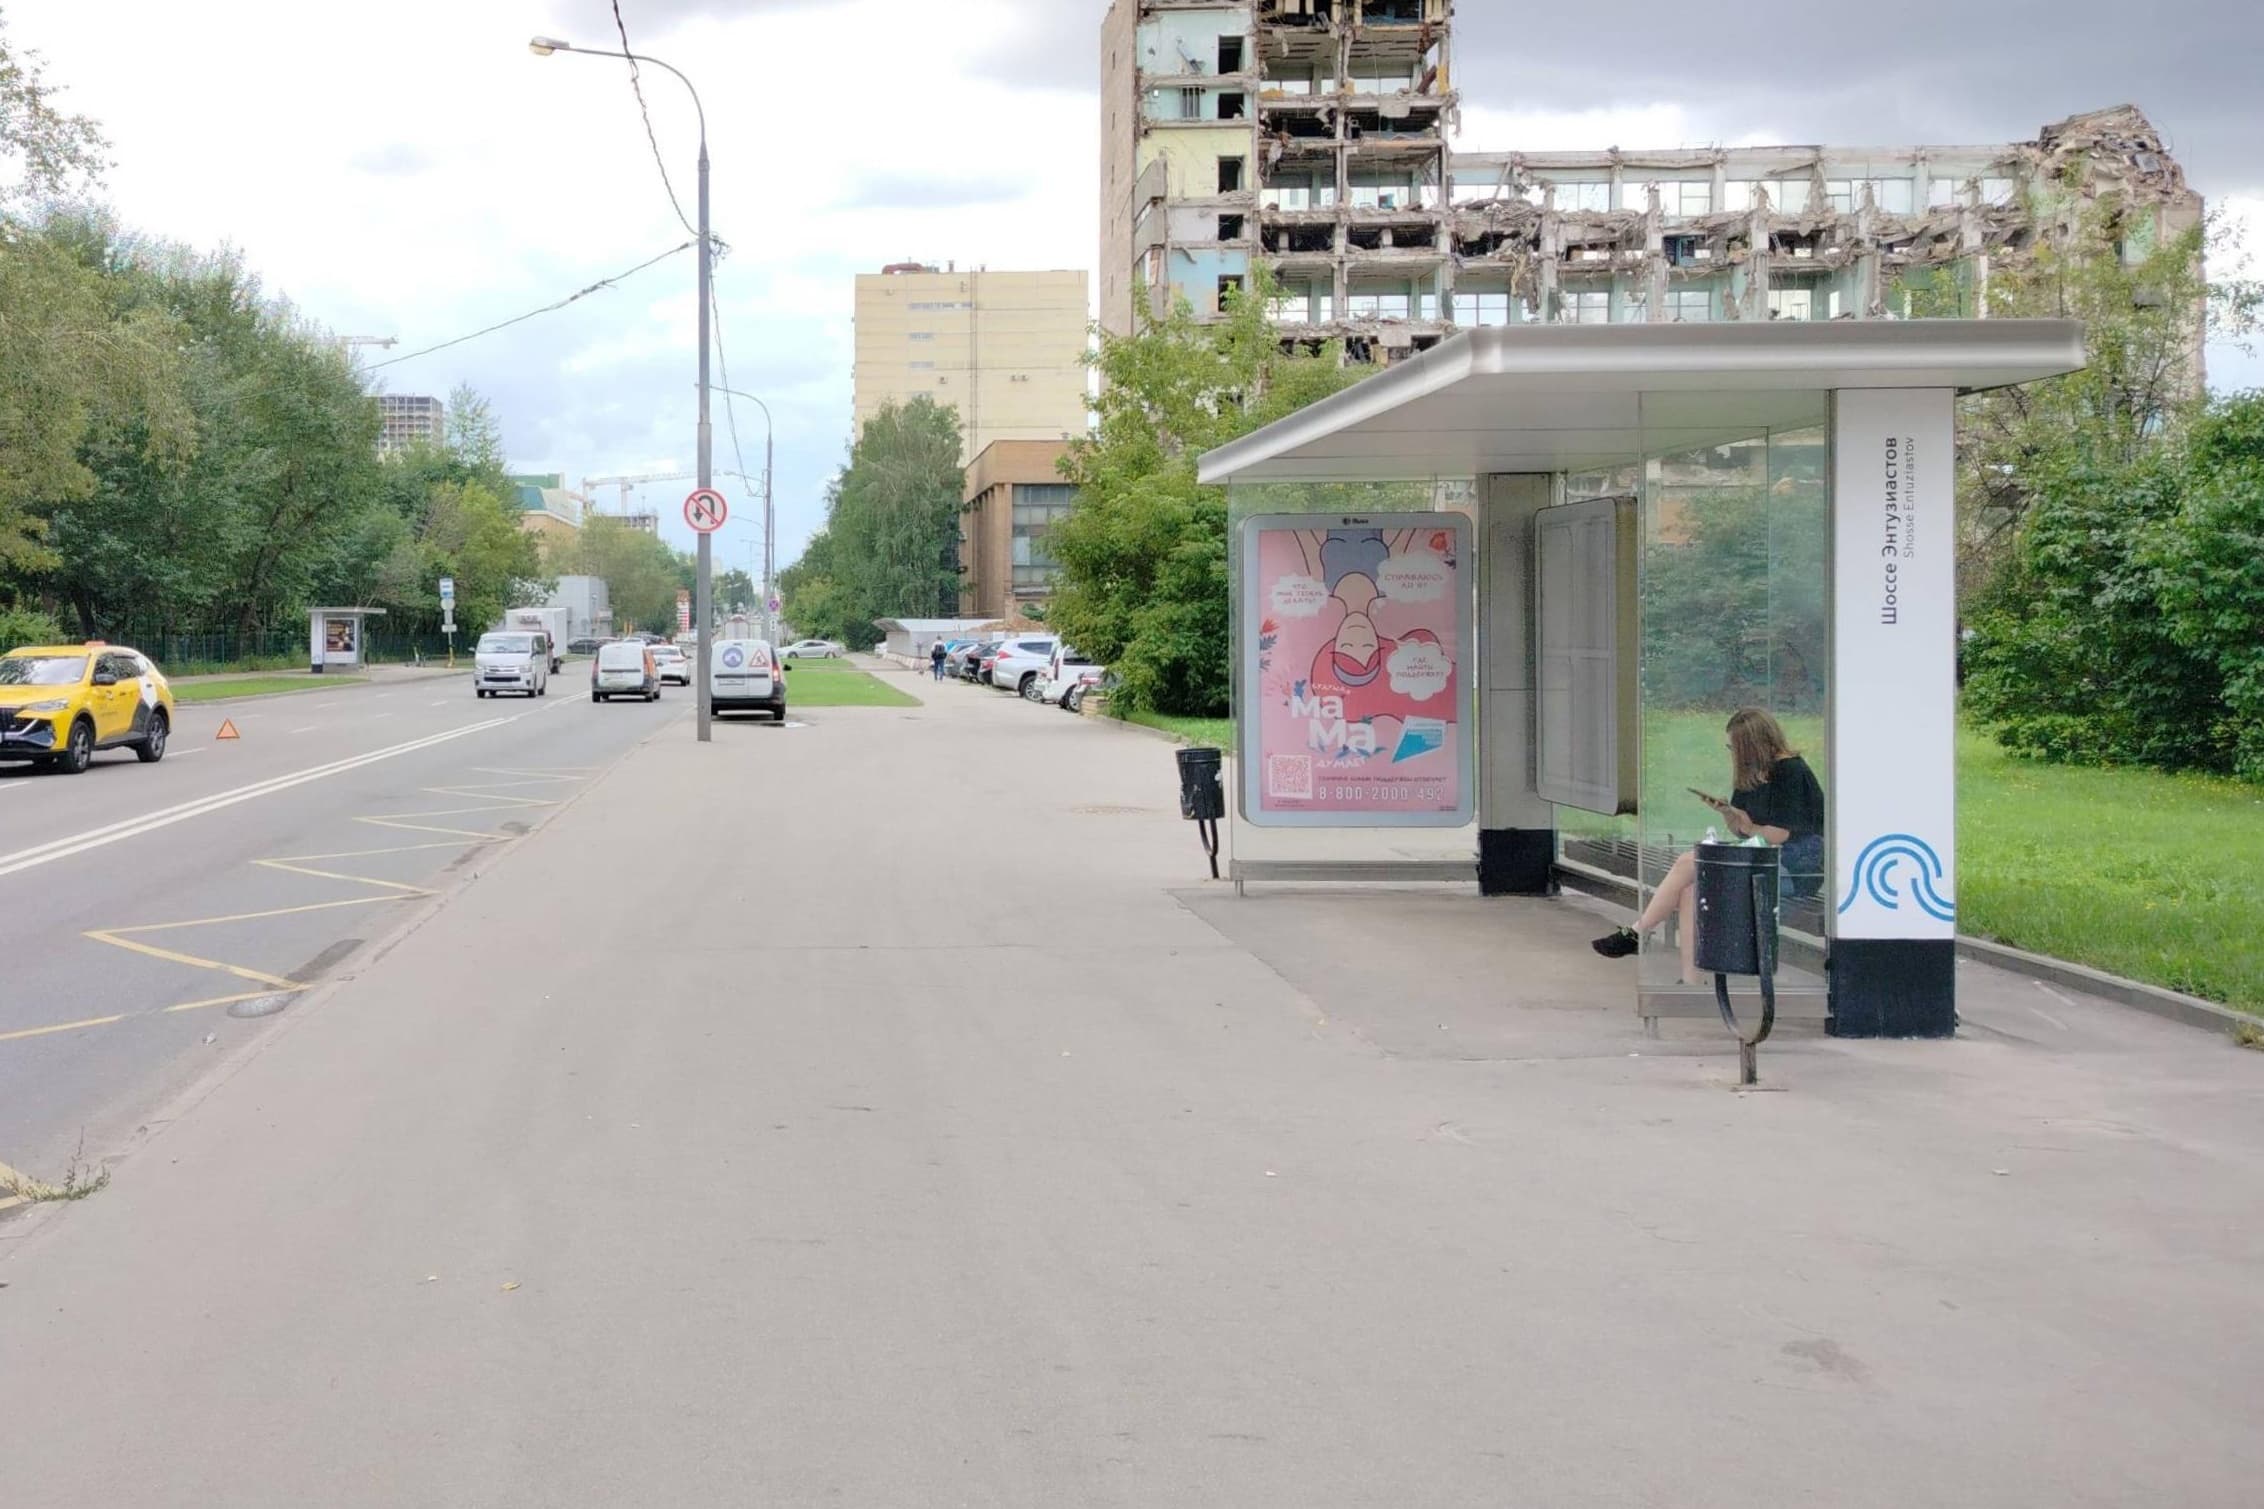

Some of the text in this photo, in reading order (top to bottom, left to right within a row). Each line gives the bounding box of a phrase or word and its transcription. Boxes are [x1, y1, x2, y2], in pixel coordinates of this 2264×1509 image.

[1881, 437, 1900, 625] Шоссе Энтузиастов
[1904, 437, 1914, 558] Shosse Entuziastov
